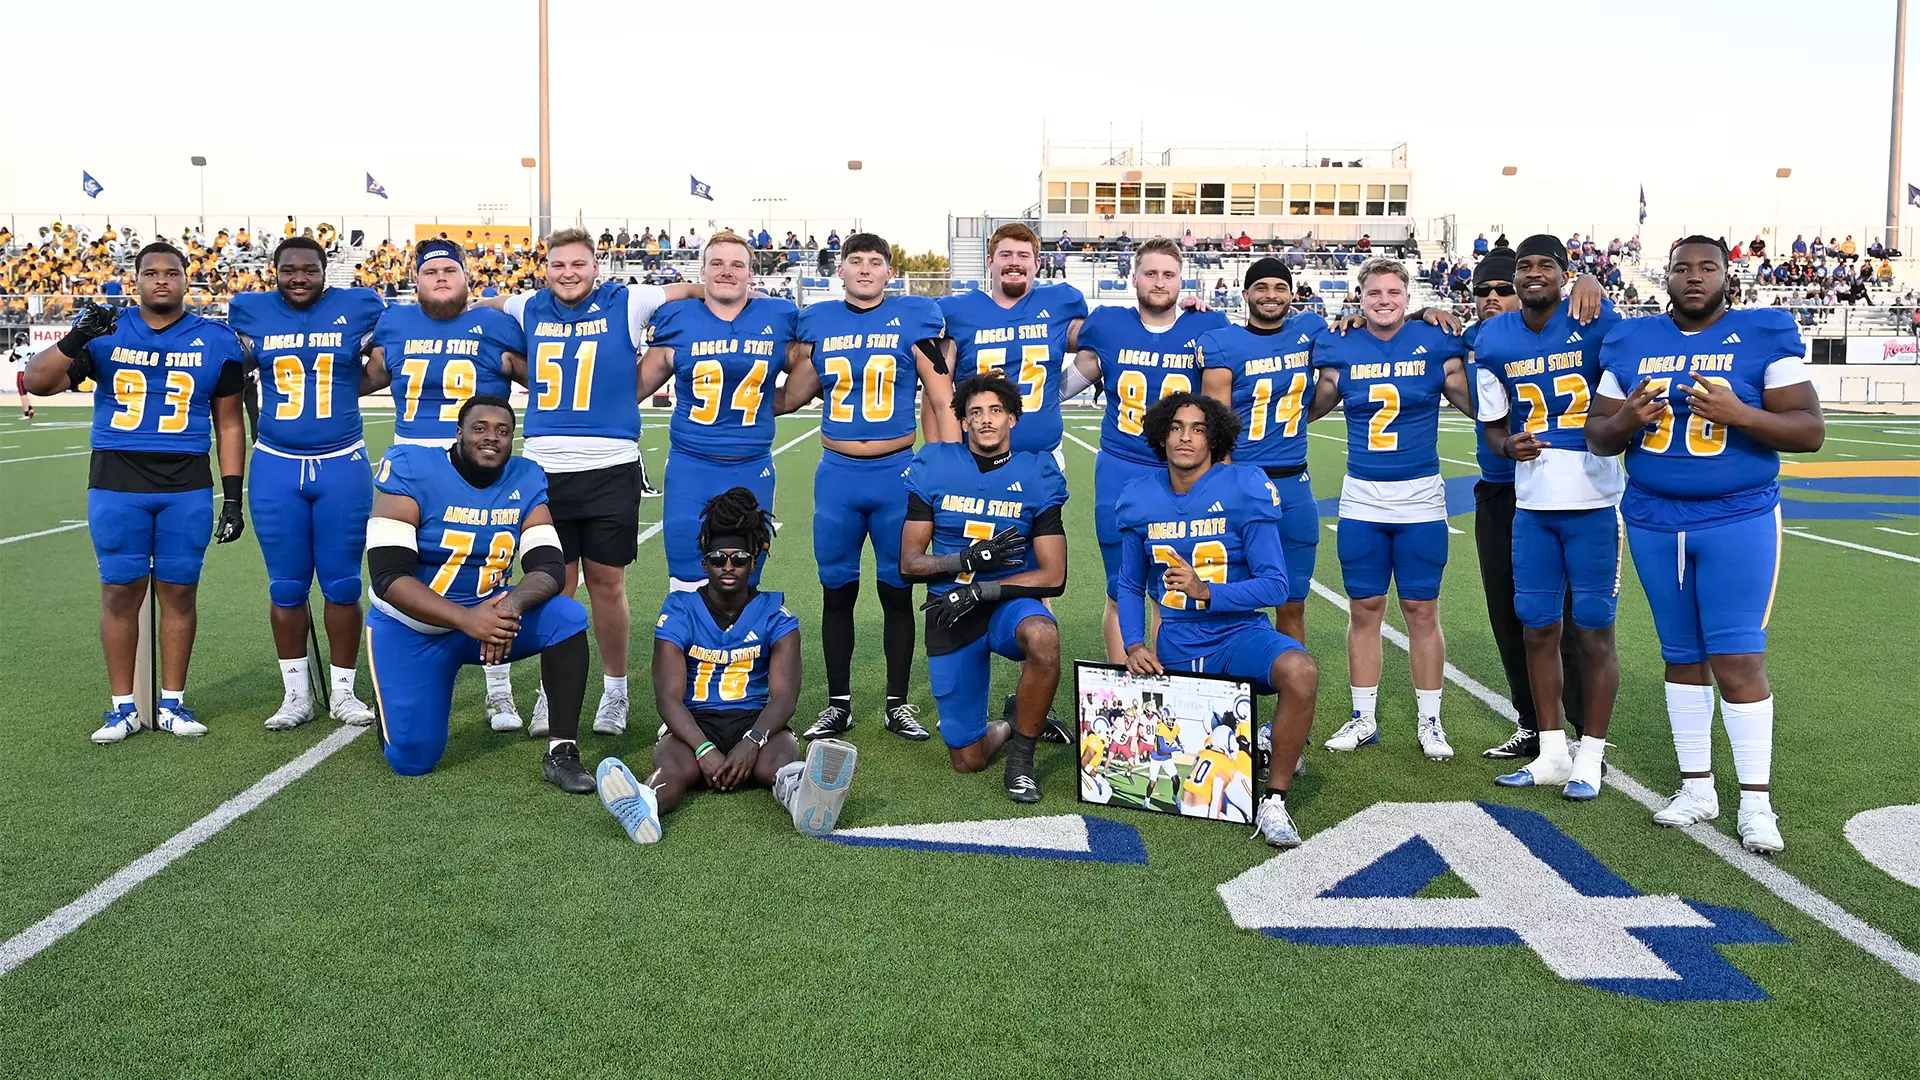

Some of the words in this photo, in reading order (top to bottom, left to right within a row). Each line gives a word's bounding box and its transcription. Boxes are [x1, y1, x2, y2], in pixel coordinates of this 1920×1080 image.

[708, 219, 716, 228] K
[1491, 224, 1500, 233] M
[1762, 227, 1770, 235] N
[534, 322, 572, 337] ANGELO
[576, 318, 608, 334] STATE
[975, 327, 1014, 344] ANGELO
[1019, 324, 1047, 339] STATE
[263, 334, 304, 350] ANGELO
[309, 333, 342, 347] STATE
[404, 340, 442, 355] ANGELO
[446, 339, 479, 355] STATE
[691, 339, 738, 356] ANGELO
[744, 340, 773, 356] STATE
[823, 335, 862, 352] ANGELO
[866, 334, 899, 349] STATE
[111, 347, 159, 366] ANGELO
[165, 352, 202, 367] STATE
[1118, 349, 1159, 367] ANGELO
[1162, 353, 1194, 369] STATE
[1245, 358, 1282, 376] ANGELO
[1284, 351, 1308, 369] STATE
[1505, 357, 1544, 378] ANGELO
[1548, 351, 1582, 371] STATE
[1638, 355, 1686, 375] ANGELO
[1690, 354, 1734, 371] STATE
[536, 341, 597, 411] 51
[1351, 363, 1390, 380] ANGELO
[1394, 360, 1425, 376] STATE
[273, 353, 334, 420] 91
[401, 359, 477, 421] 79
[689, 360, 768, 426] 94
[825, 355, 896, 422] 20
[110, 369, 195, 433] 93
[1246, 373, 1307, 441] 14
[1368, 383, 1401, 451] 2
[443, 506, 487, 524] ANGELO
[490, 509, 520, 525] STATE
[941, 494, 984, 514] ANGELO
[987, 500, 1022, 518] STATE
[1148, 521, 1186, 540] ANGELO
[1189, 518, 1226, 537] STATE
[428, 529, 516, 598] 78
[689, 645, 727, 664] ANGELO
[731, 645, 760, 663] STATE
[692, 661, 753, 701] 16
[1119, 733, 1127, 743] 5
[1146, 725, 1155, 735] 81
